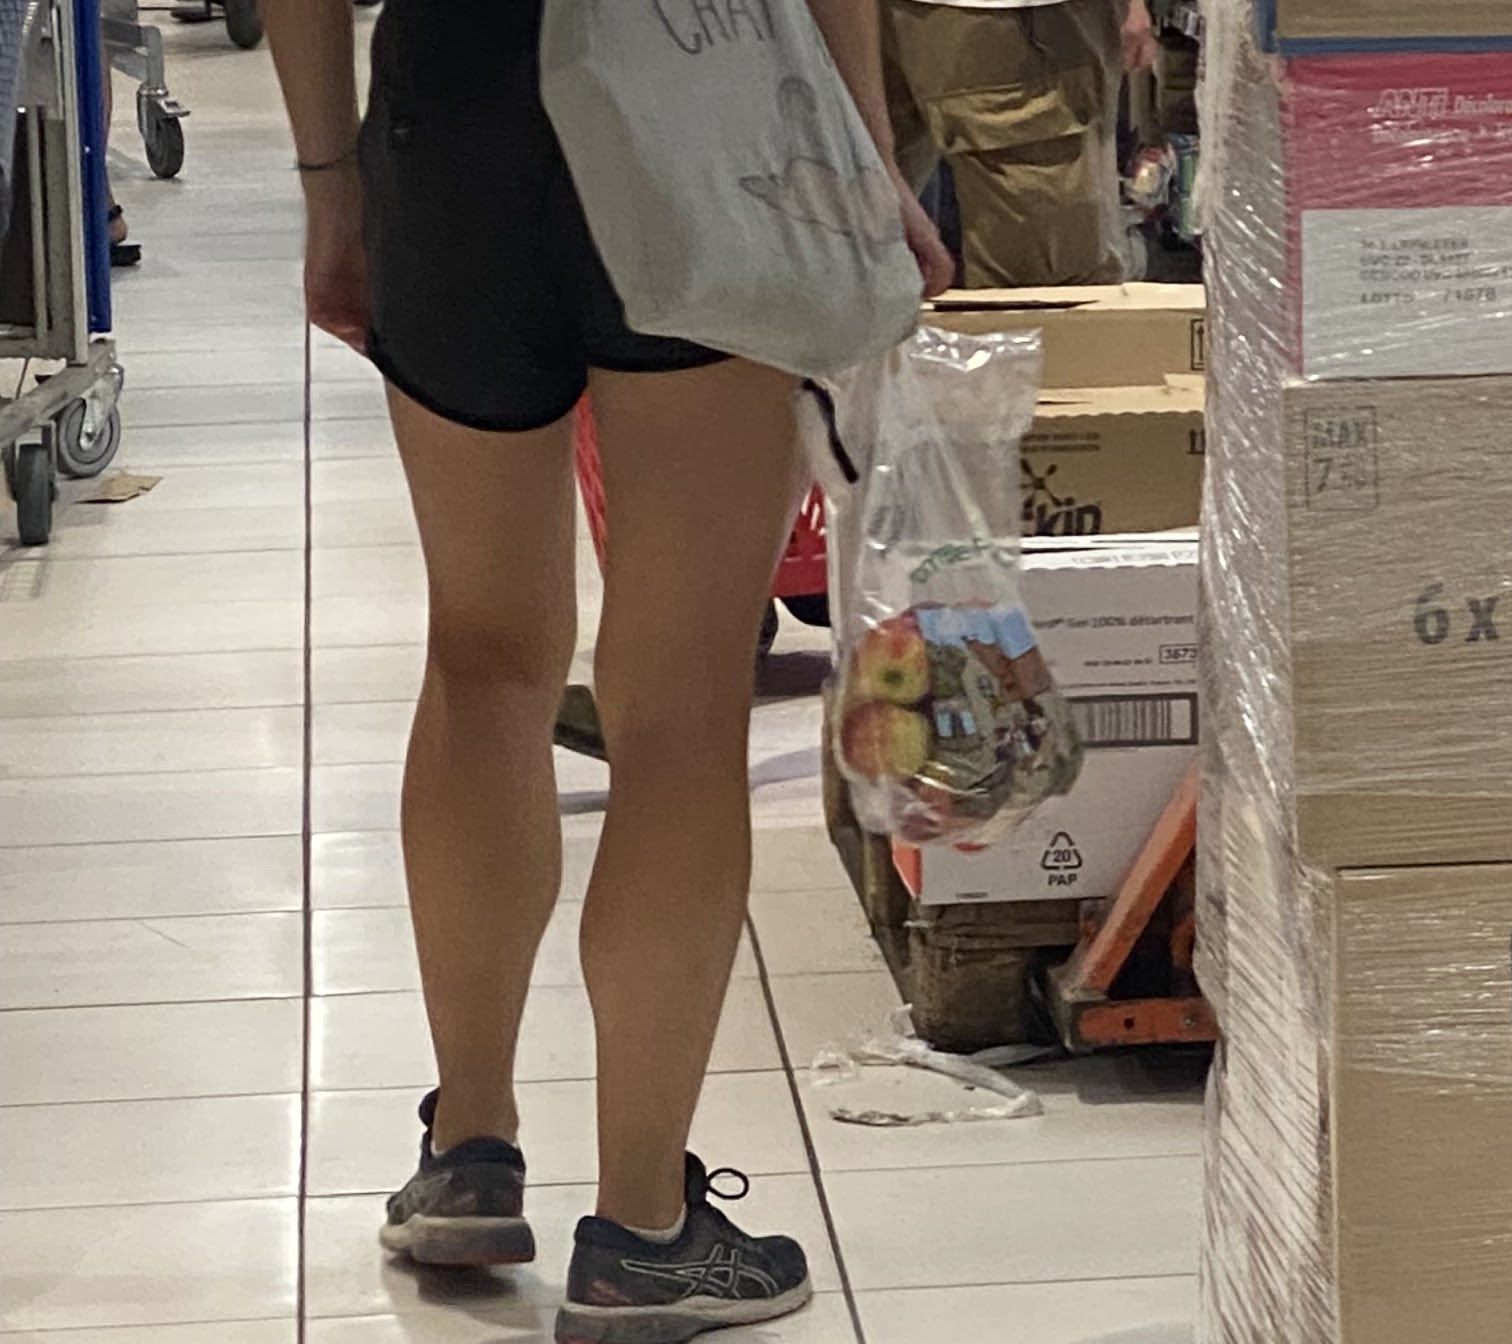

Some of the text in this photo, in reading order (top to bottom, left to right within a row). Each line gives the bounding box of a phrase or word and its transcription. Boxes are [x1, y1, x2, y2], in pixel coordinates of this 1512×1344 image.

[1414, 583, 1449, 646] 6
[1053, 849, 1072, 865] 20
[1048, 872, 1077, 887] PAP
